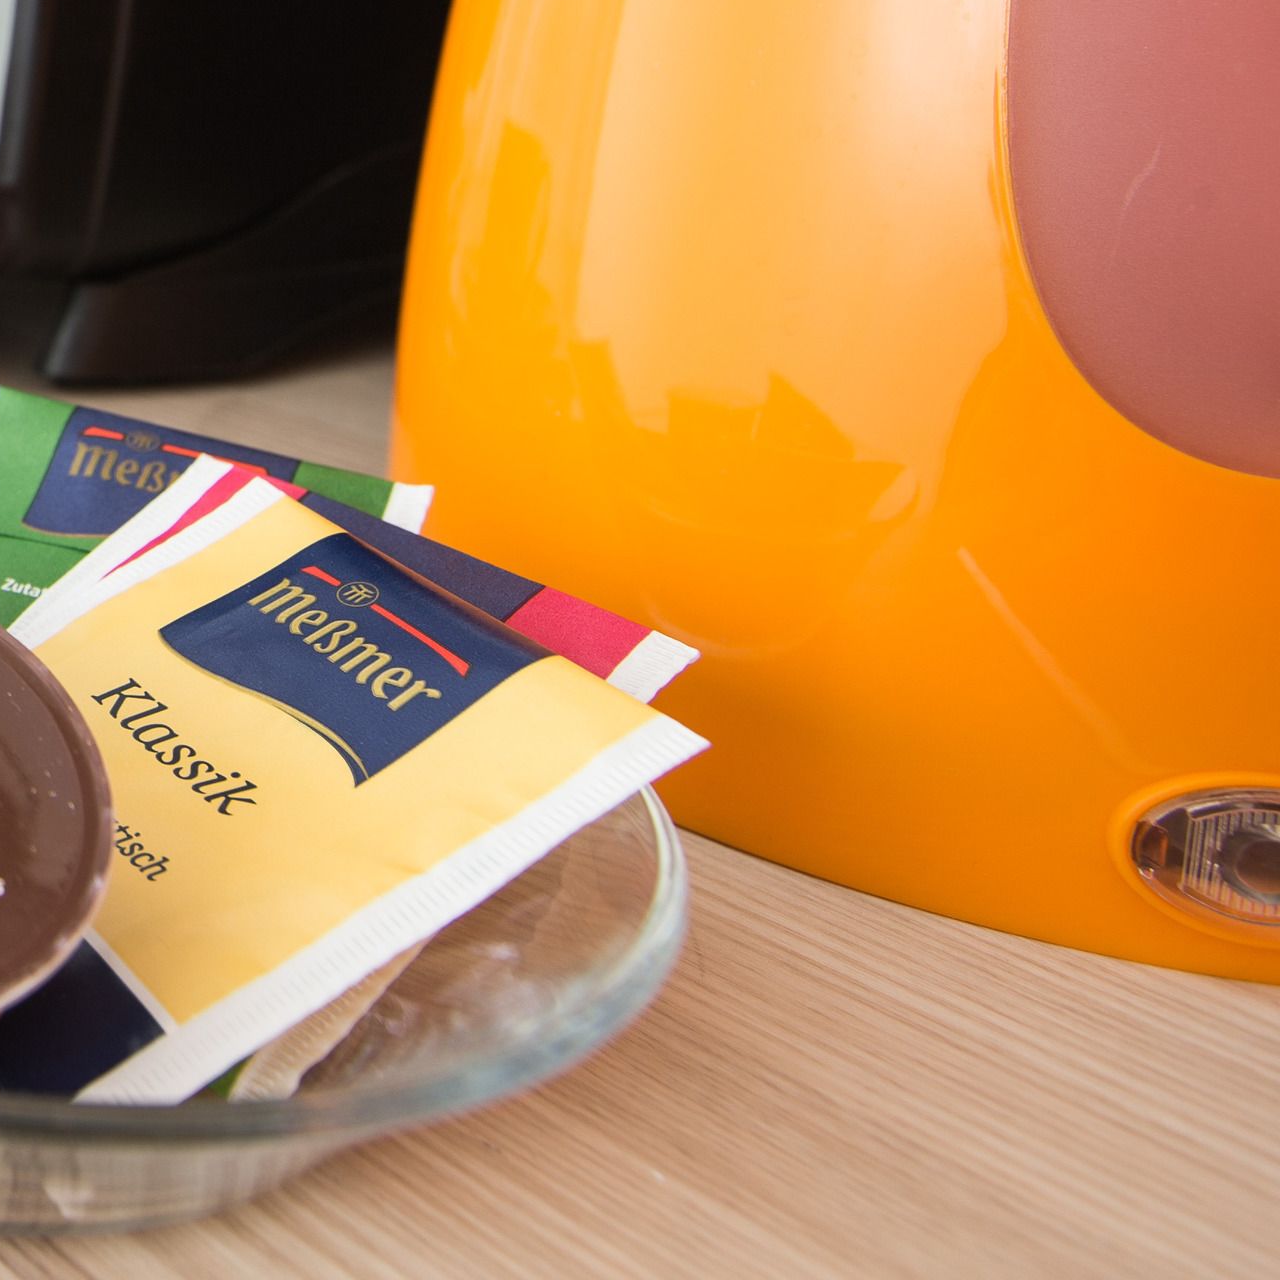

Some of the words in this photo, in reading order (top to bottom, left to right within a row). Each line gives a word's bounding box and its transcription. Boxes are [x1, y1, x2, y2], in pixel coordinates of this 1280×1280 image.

[69, 441, 181, 493] Meß
[0, 577, 46, 598] Zuta
[90, 677, 259, 816] Klassik
[113, 819, 171, 882] tisch
